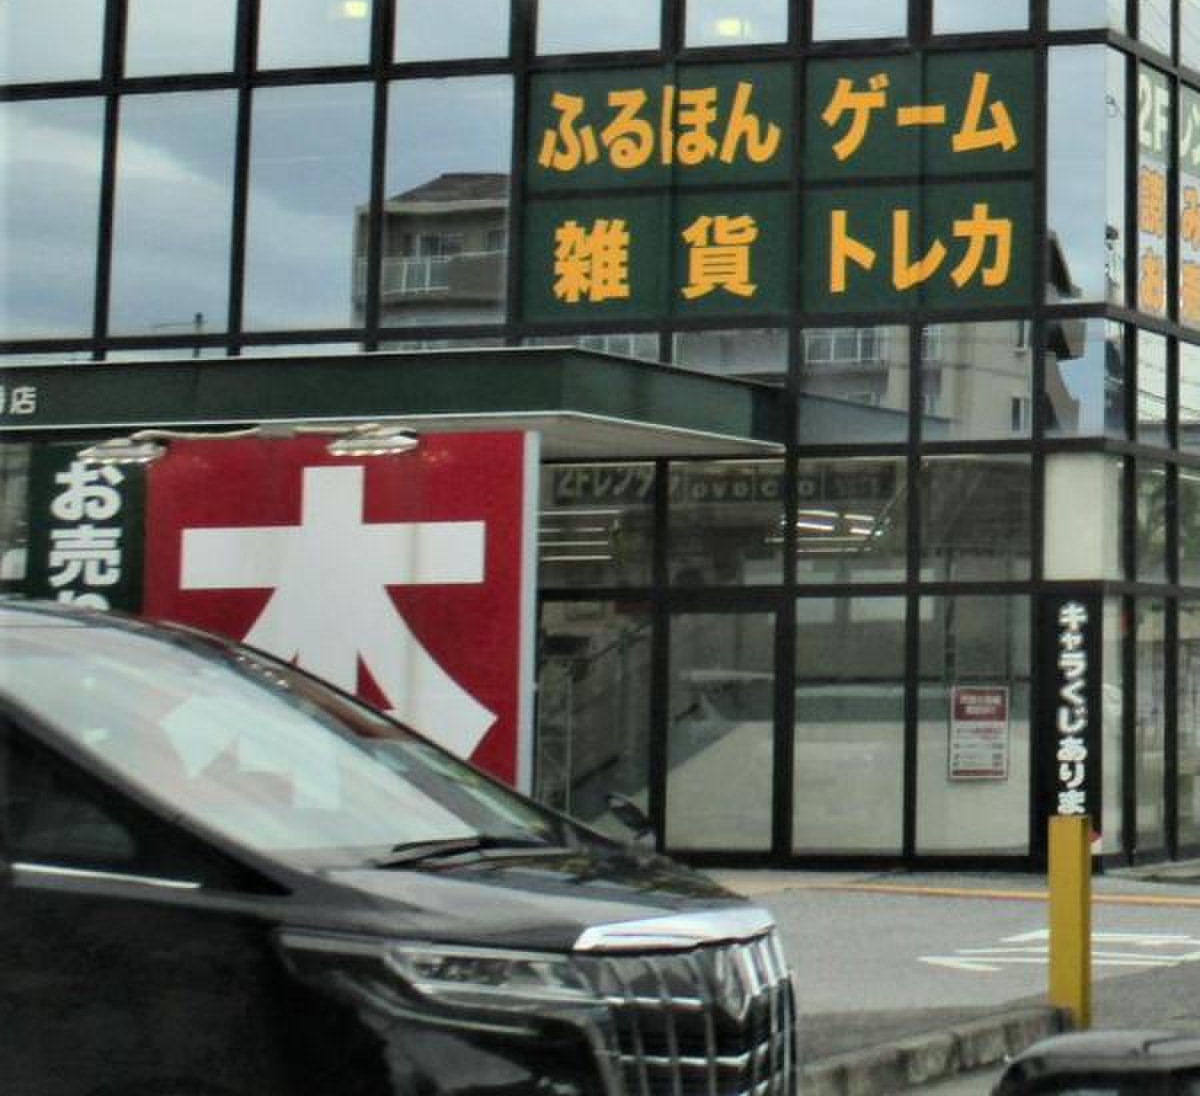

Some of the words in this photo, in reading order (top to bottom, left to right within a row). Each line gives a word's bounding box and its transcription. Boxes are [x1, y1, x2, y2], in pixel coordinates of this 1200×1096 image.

[538, 81, 782, 172] ふるほん
[821, 71, 1019, 162] ゲーム
[552, 214, 761, 304] 雑貨
[828, 203, 1014, 294] トレカ
[0, 385, 37, 415] 店
